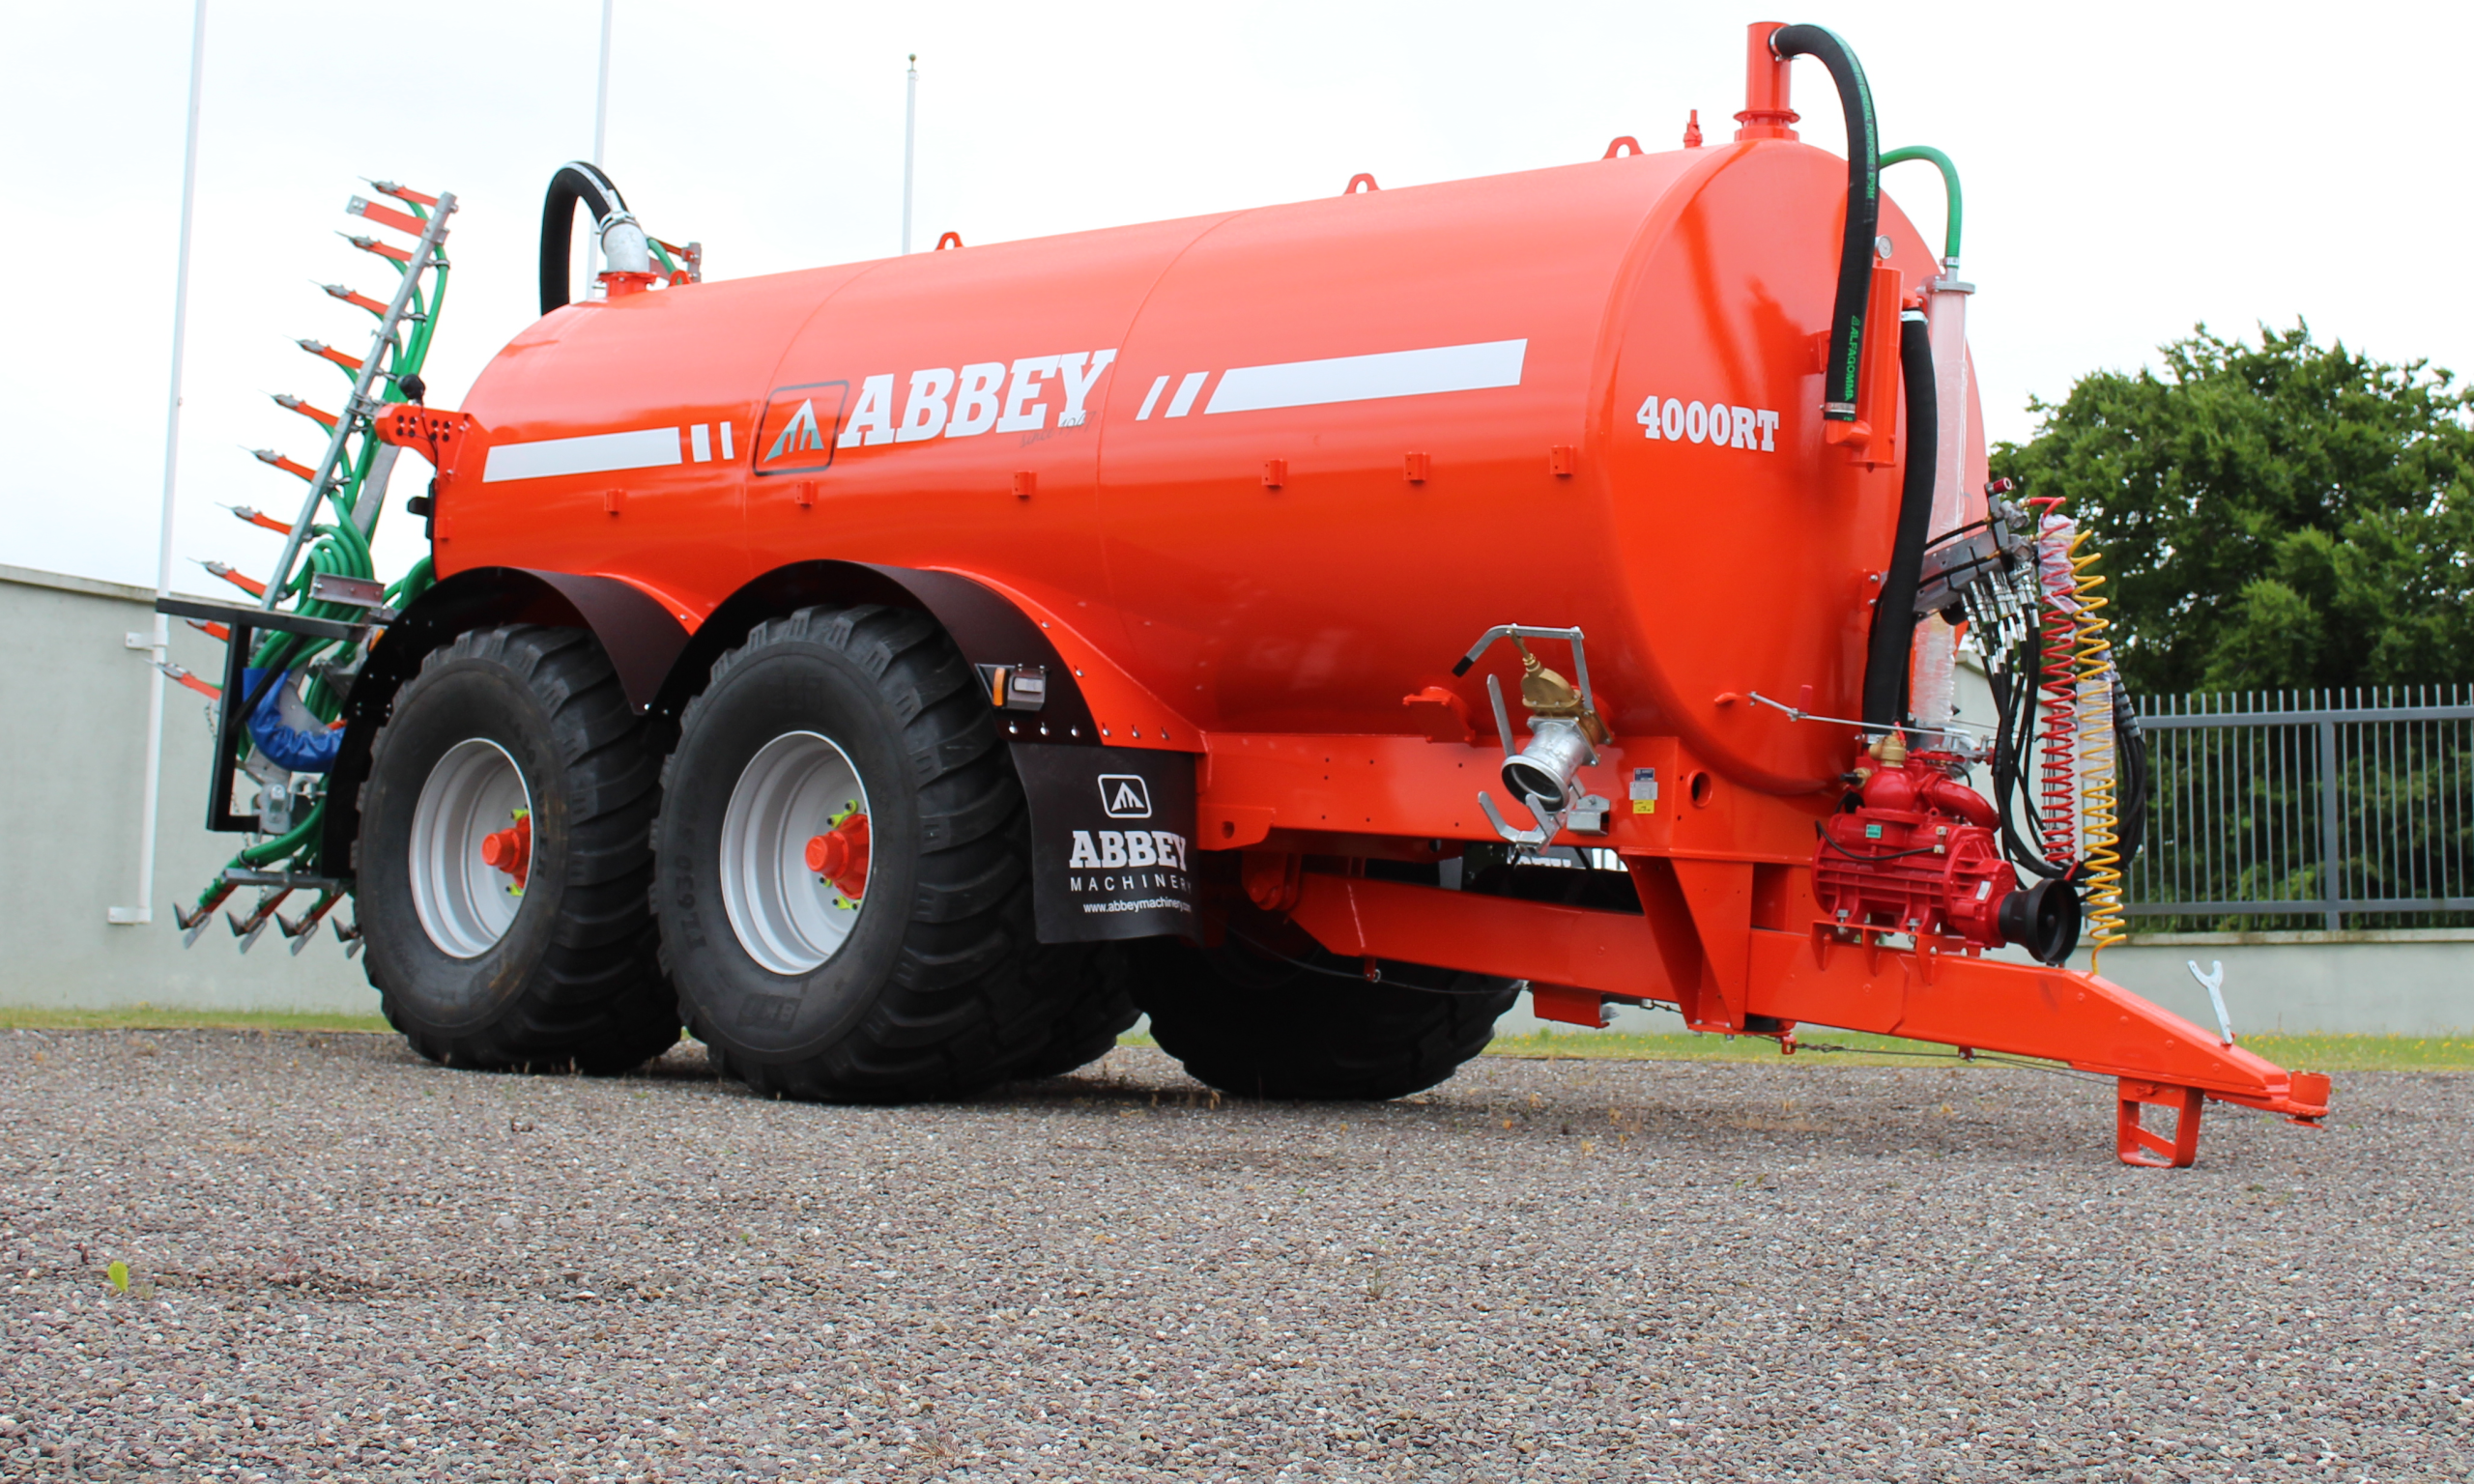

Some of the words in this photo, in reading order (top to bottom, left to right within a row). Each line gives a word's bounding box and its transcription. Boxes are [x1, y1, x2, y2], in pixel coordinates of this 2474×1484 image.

[1859, 85, 1873, 121] GENERAL
[1866, 124, 1875, 163] PURPOSE
[1845, 327, 1858, 402] ALFAGOMMA
[837, 349, 1117, 448] ABBEY
[1636, 395, 1780, 452] 4000RT
[1069, 831, 1187, 871] ABBEY
[1070, 873, 1192, 894] MACHINERY
